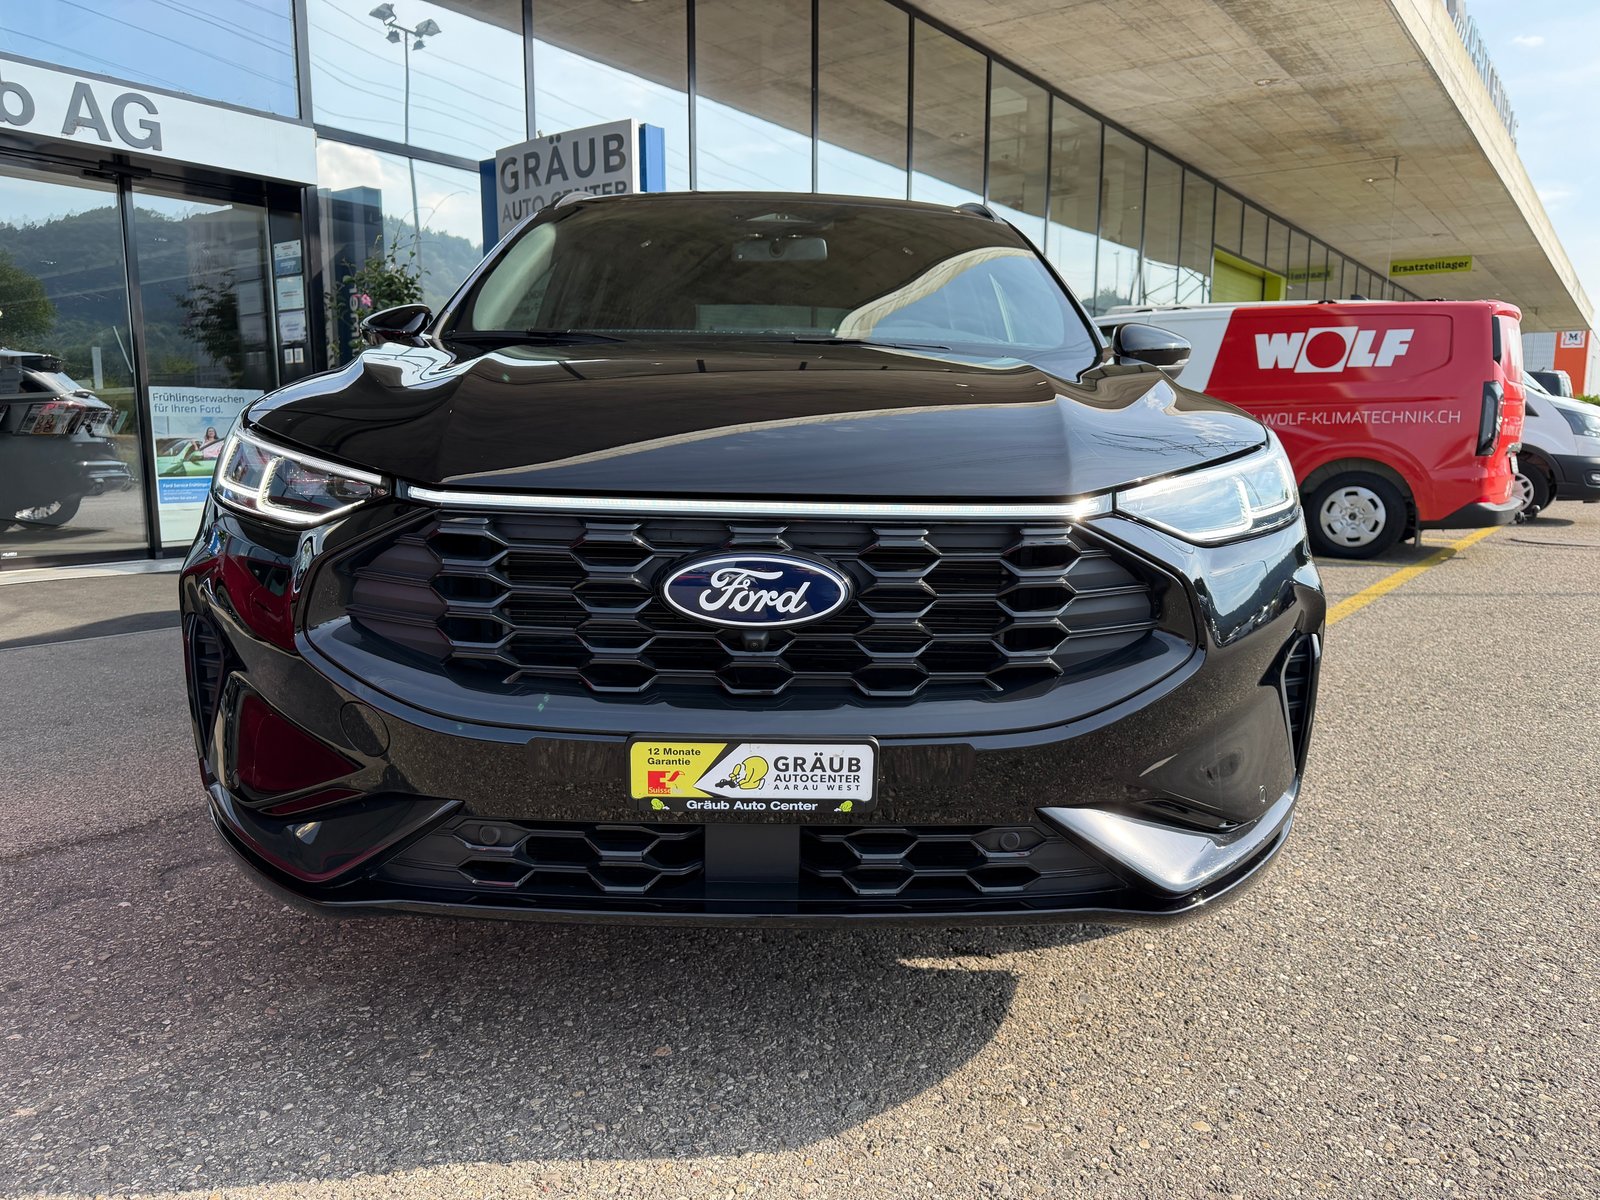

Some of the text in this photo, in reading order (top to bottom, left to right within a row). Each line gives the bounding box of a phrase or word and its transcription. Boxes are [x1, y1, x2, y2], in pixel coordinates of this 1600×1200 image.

[61, 82, 163, 151] AG
[500, 133, 627, 195] GRÄUB
[502, 197, 545, 223] AUTO
[1392, 260, 1469, 273] Ersatzteillager
[1568, 333, 1578, 341] M
[1255, 326, 1415, 373] WOLF
[153, 392, 245, 404] Frühlingserwachen
[154, 404, 223, 414] für Ihren Ford.
[699, 567, 811, 613] Ford
[648, 748, 701, 756] 12 Monate
[647, 757, 691, 766] Garantie
[774, 752, 861, 773] GRÄUB
[774, 773, 861, 783] AUTOCENTER
[686, 799, 819, 811] Gräub Auto Center
